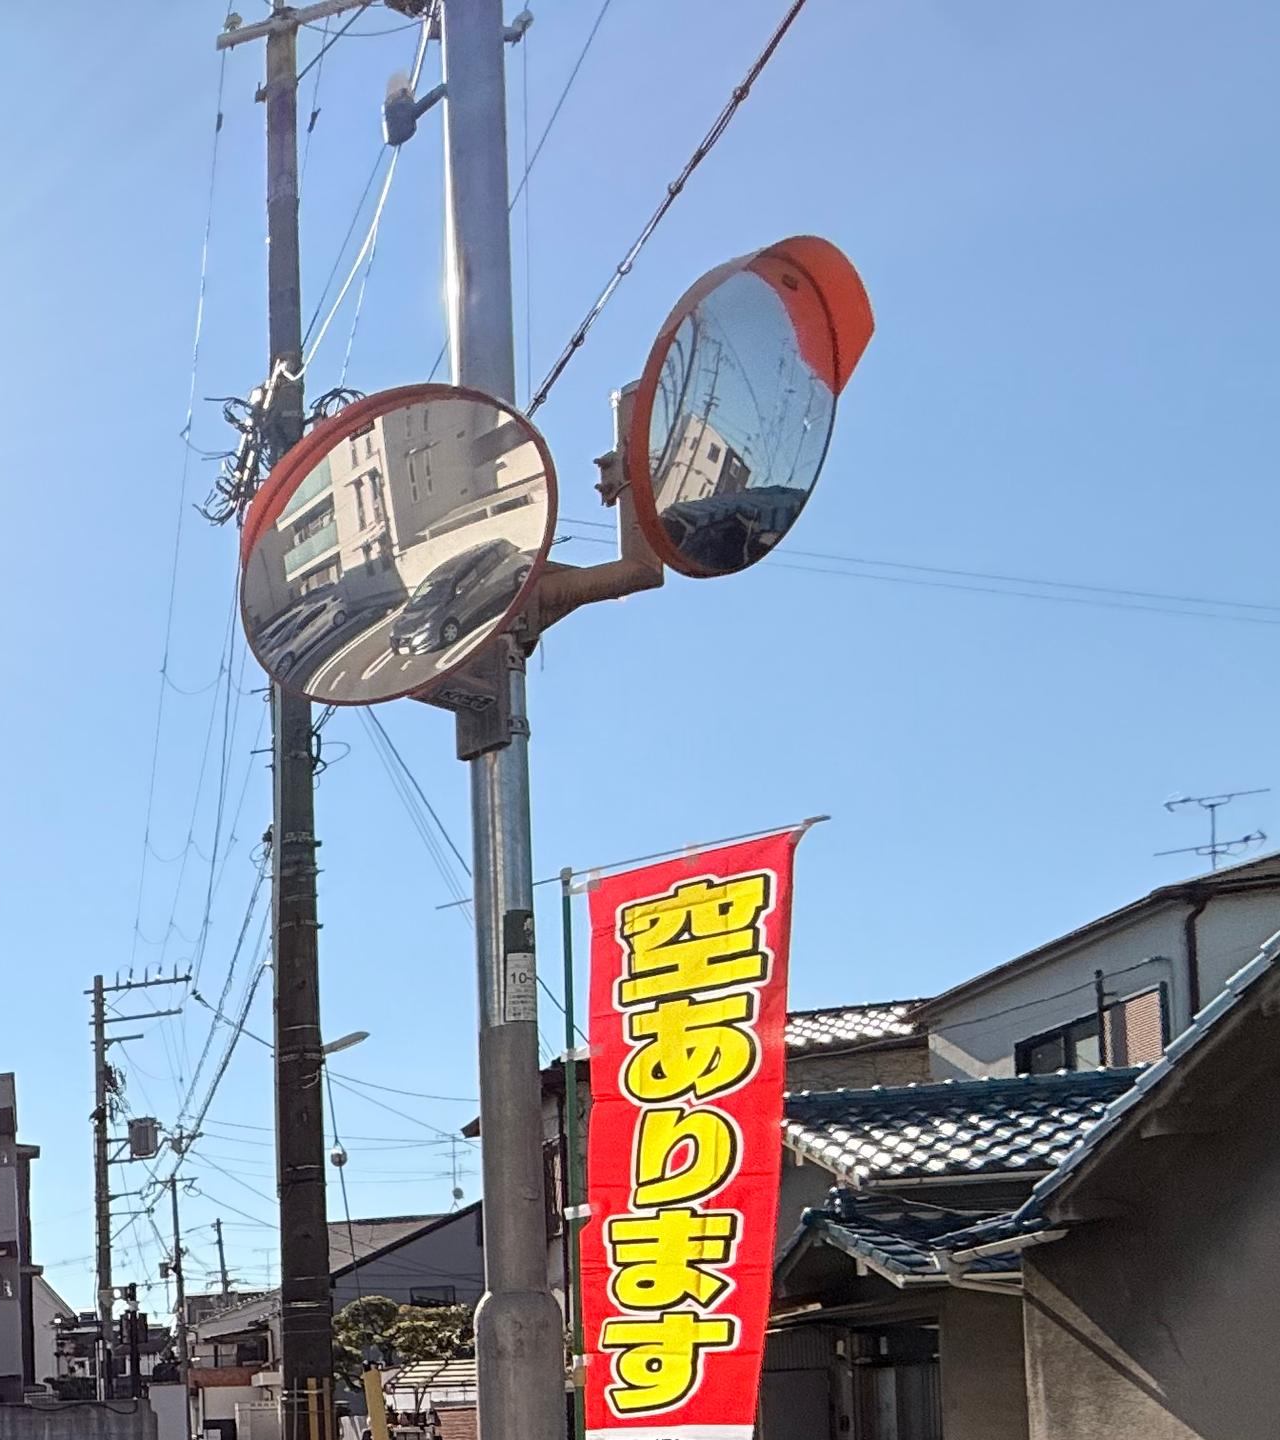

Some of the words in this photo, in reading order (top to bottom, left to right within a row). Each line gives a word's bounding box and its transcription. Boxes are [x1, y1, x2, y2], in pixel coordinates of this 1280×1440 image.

[601, 872, 770, 1413] 空あります
